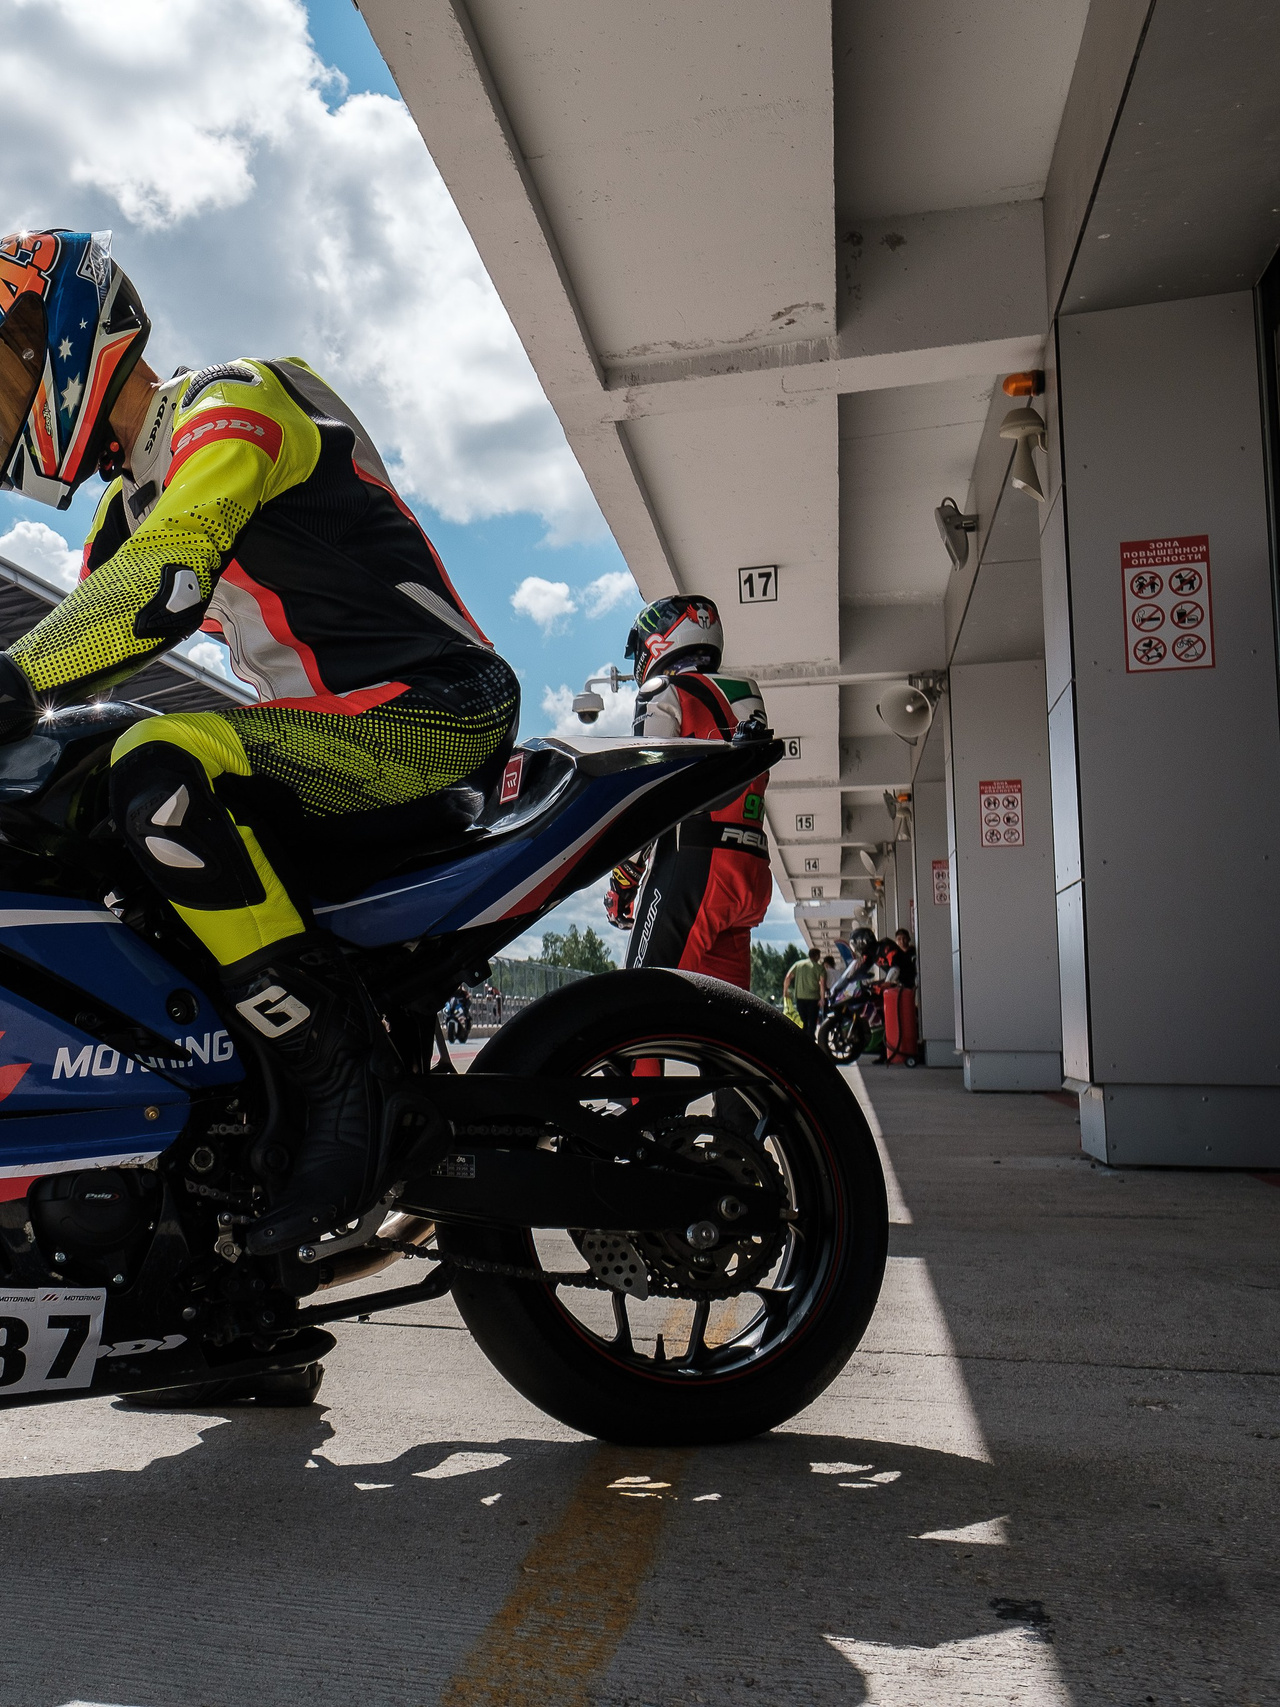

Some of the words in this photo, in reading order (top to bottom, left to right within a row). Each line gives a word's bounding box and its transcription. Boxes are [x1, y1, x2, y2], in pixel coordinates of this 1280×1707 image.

[144, 395, 169, 456] SPIDI
[174, 418, 266, 457] SPIDI
[1149, 540, 1180, 550] ЗОНА
[1123, 544, 1207, 560] ПОВЫШЕННОЙ
[1131, 553, 1202, 566] ОПАСНОСТИ
[743, 571, 773, 599] 17
[797, 816, 812, 830] 15
[806, 860, 818, 870] 14
[84, 1192, 113, 1201] Puig
[63, 1294, 101, 1302] MOTORING
